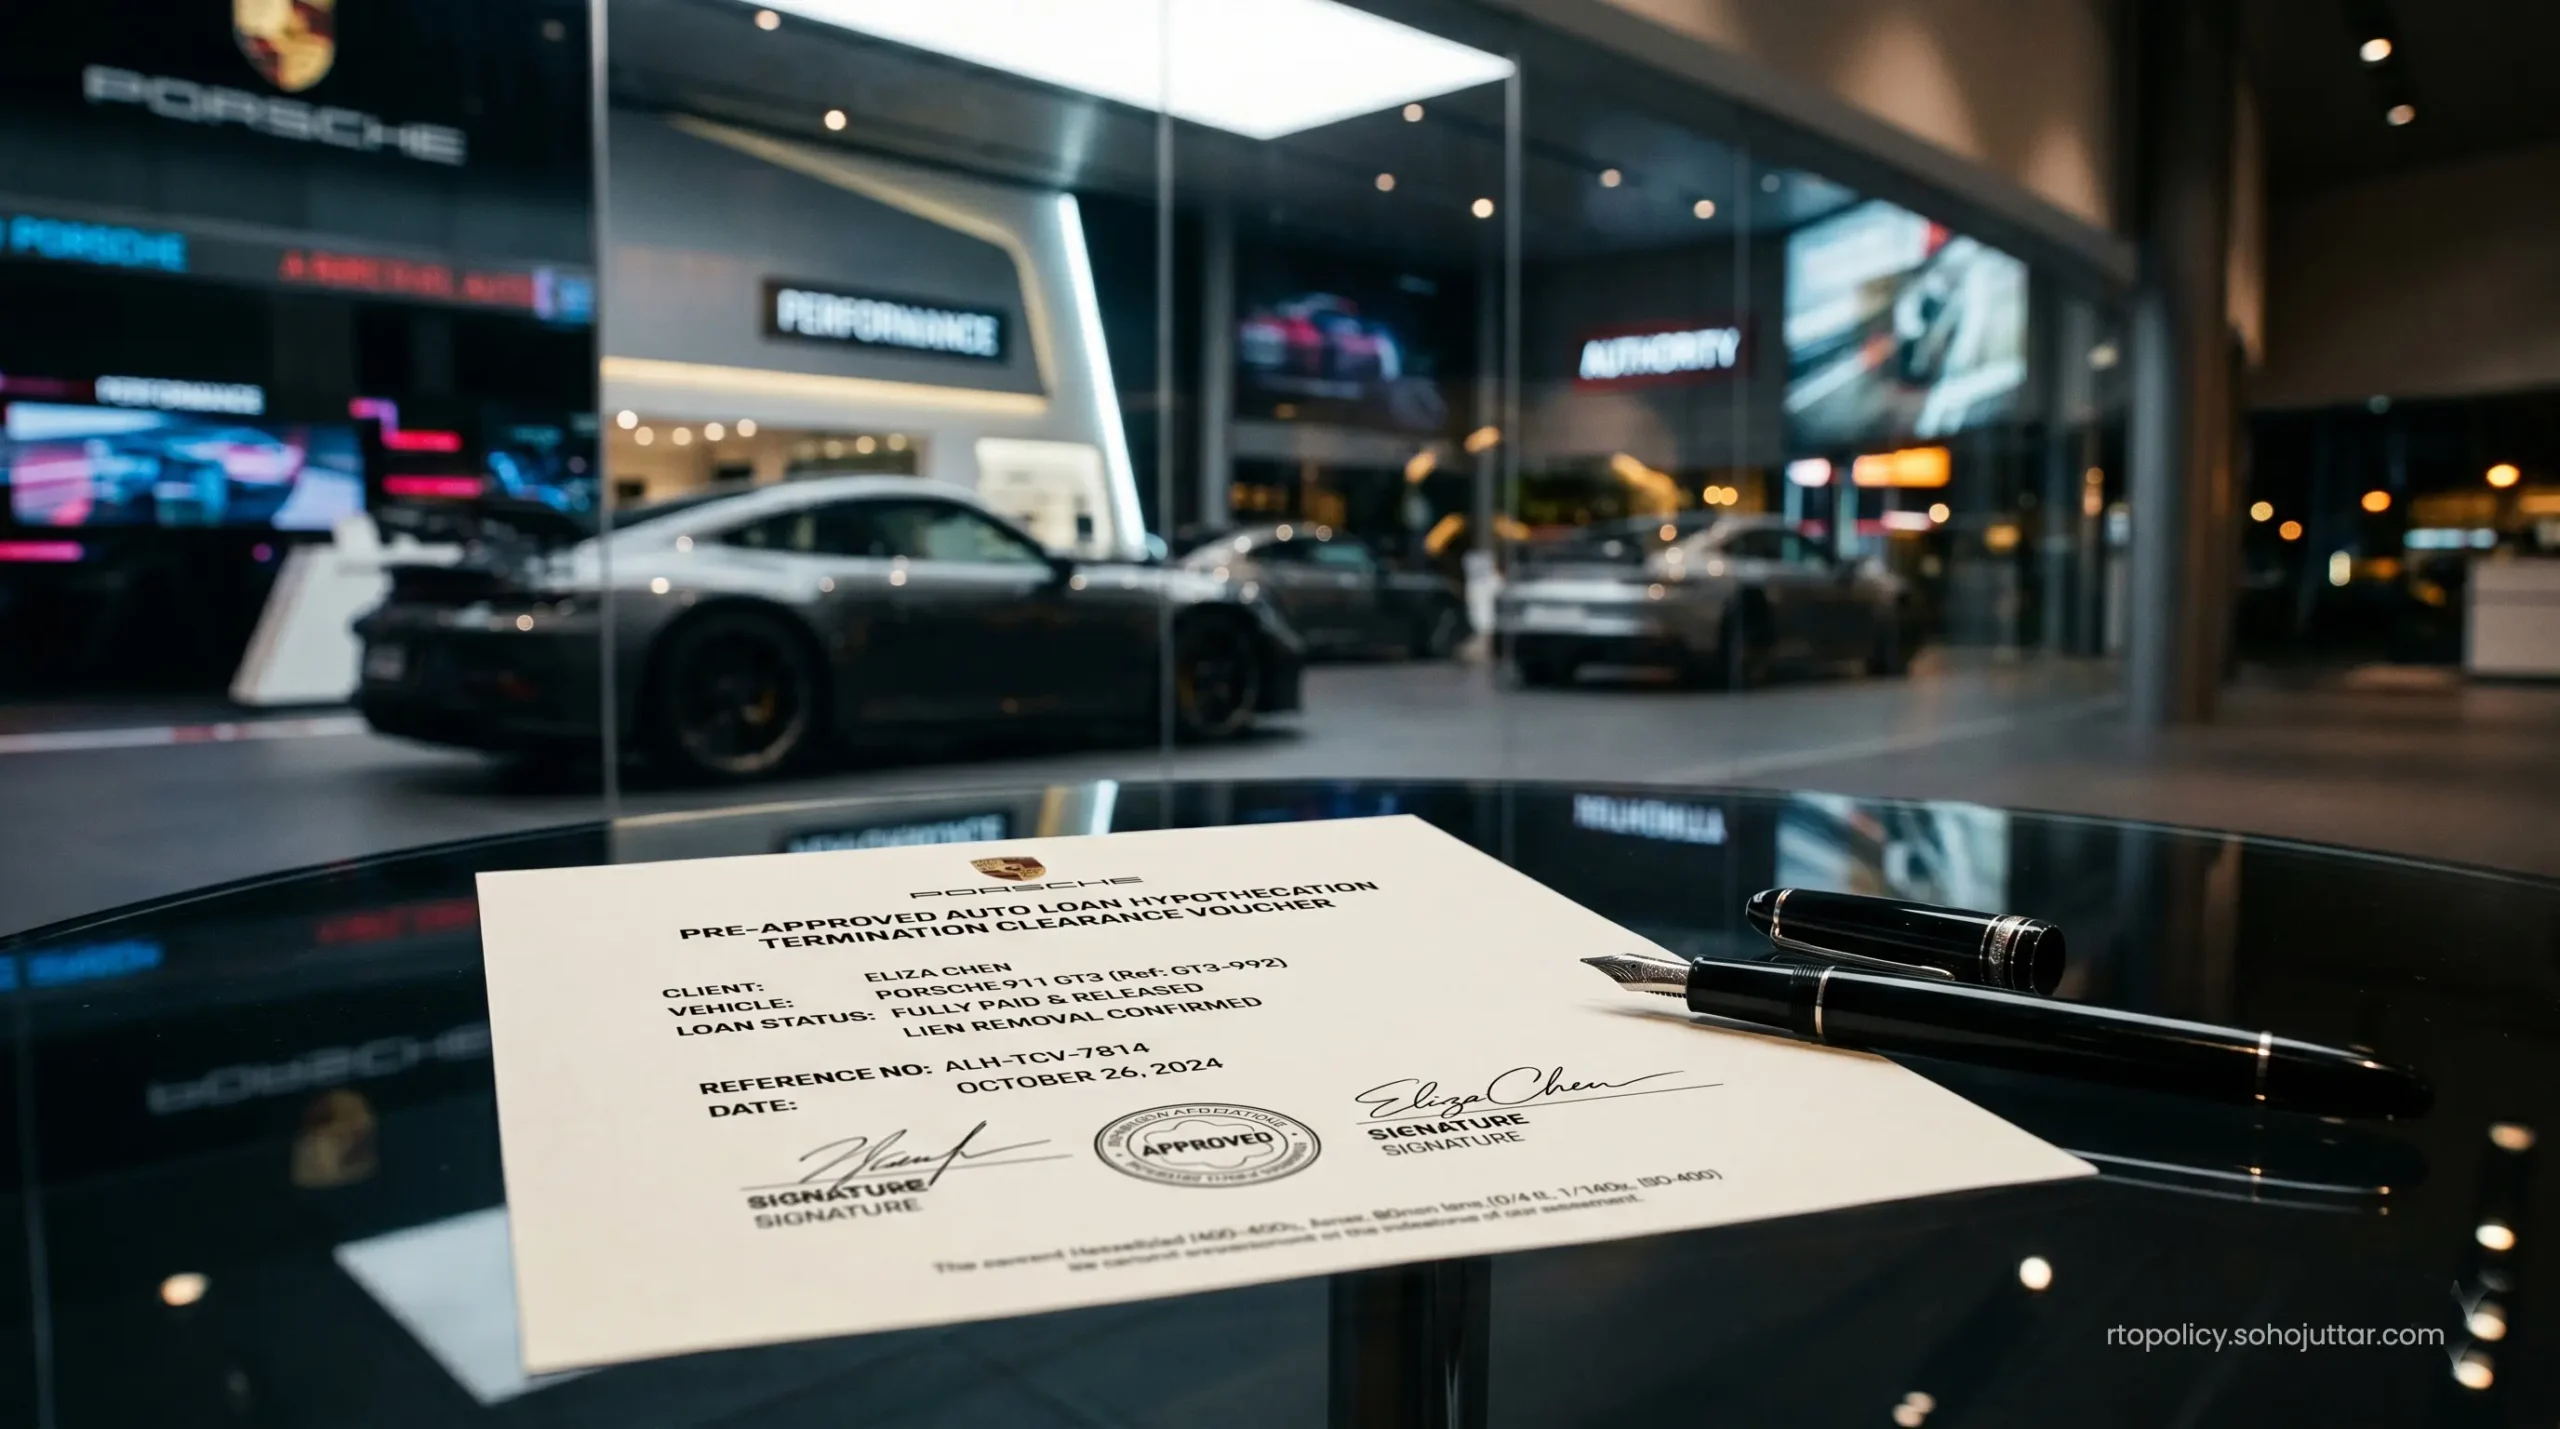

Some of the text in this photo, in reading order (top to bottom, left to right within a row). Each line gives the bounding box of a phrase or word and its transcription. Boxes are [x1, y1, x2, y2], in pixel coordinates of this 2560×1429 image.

[83, 64, 466, 165] PORSCHE
[777, 288, 1000, 357] PERFORMANCE
[1579, 326, 1741, 380] AUTHORITY
[679, 881, 1380, 940] PRE-APPROVED AUTO LOAN HYPOTHECATION
[909, 876, 1144, 899] PORSCHE
[758, 897, 1336, 949] TERMINATION CLEARANCE VOUCHER
[662, 962, 1013, 999] CLIENT: ELIZA CHEN
[667, 957, 1289, 1017] VEHICLE: PORSCHE 911 GT3 (Ref: GT3-992)
[676, 982, 1205, 1037] LOAN STATUS: FULLY PAID & RELEASED
[902, 996, 1264, 1038] LIEN REMOVAL CONFIRMED
[699, 1042, 1151, 1095] REFERENCE NO: ALH-TCV-7814
[708, 1057, 1225, 1118] DATE: OCTOBER 26, 2024
[1142, 1131, 1275, 1158] APPROVED
[1380, 1130, 1526, 1157] SIGNATURE
[747, 1178, 930, 1209] SIGNATURE
[753, 1198, 922, 1230] SIGNATURE
